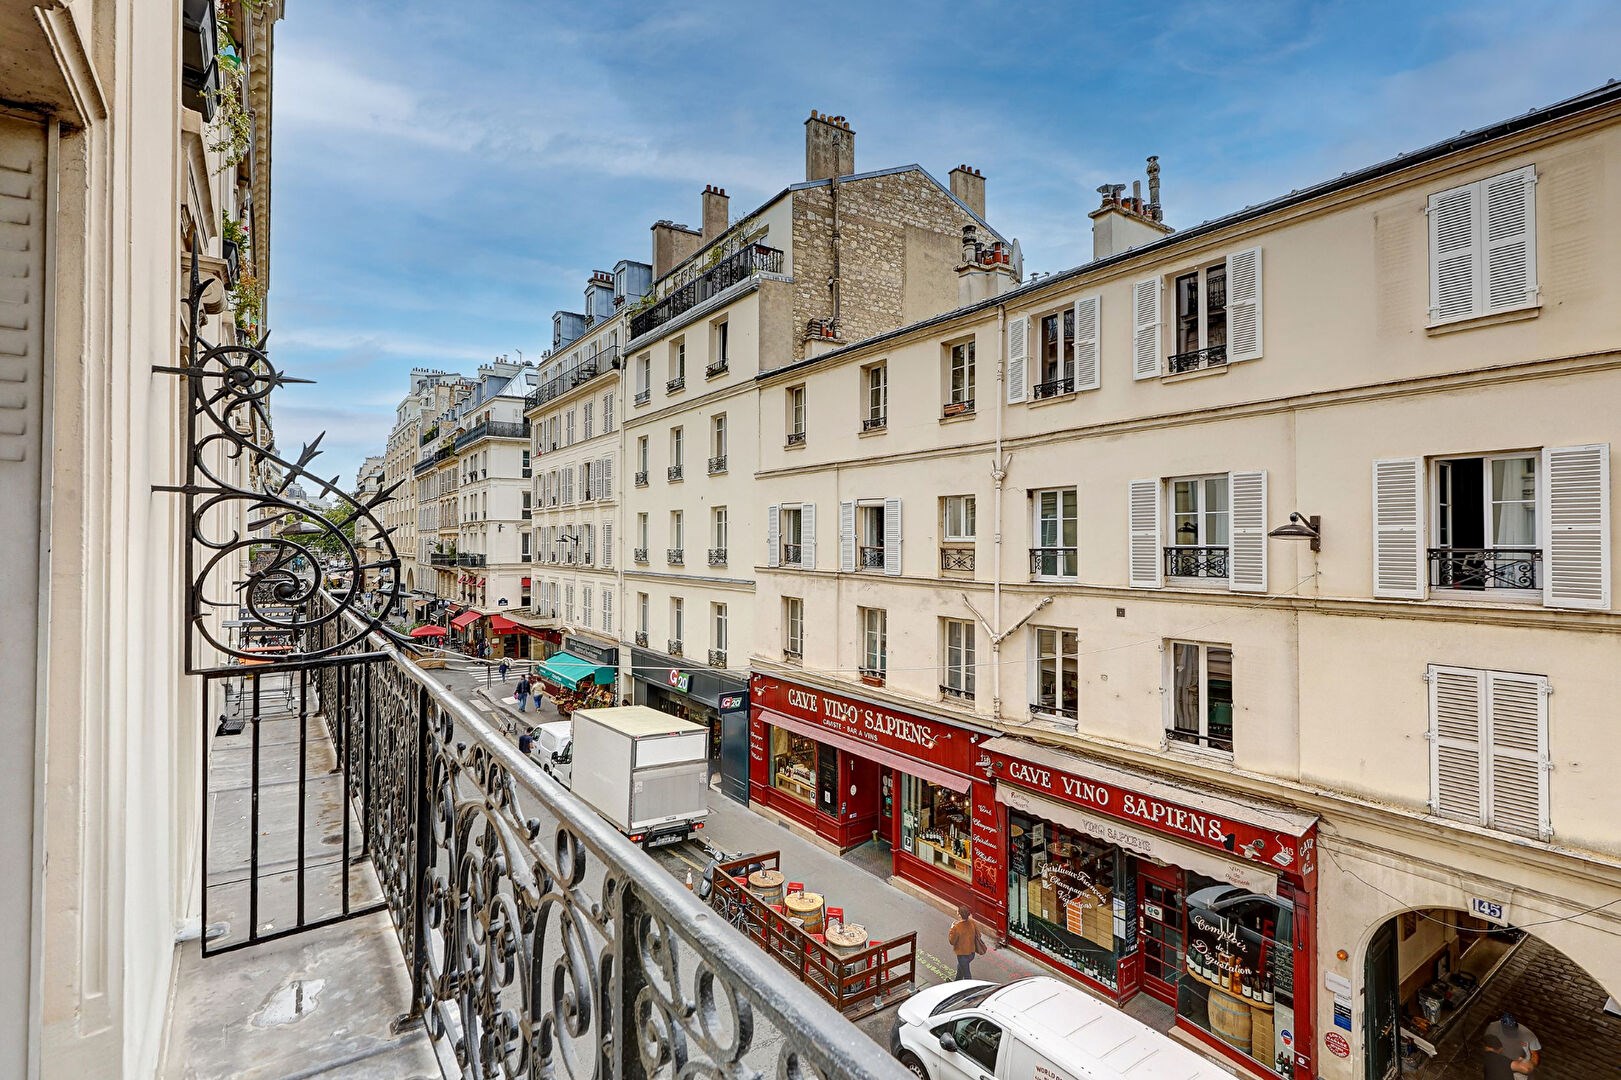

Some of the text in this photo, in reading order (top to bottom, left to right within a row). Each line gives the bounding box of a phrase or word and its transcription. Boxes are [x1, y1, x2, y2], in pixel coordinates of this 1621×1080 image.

[788, 688, 932, 748] CAVE VINO SAPIENS
[846, 726, 858, 735] BAR
[1010, 761, 1052, 789] CAVE
[1060, 775, 1110, 806] VINO
[1123, 794, 1224, 841] SAPIENS
[1474, 898, 1501, 918] 145
[1194, 915, 1249, 953] Comptoir
[1035, 1065, 1056, 1079] WORLD
